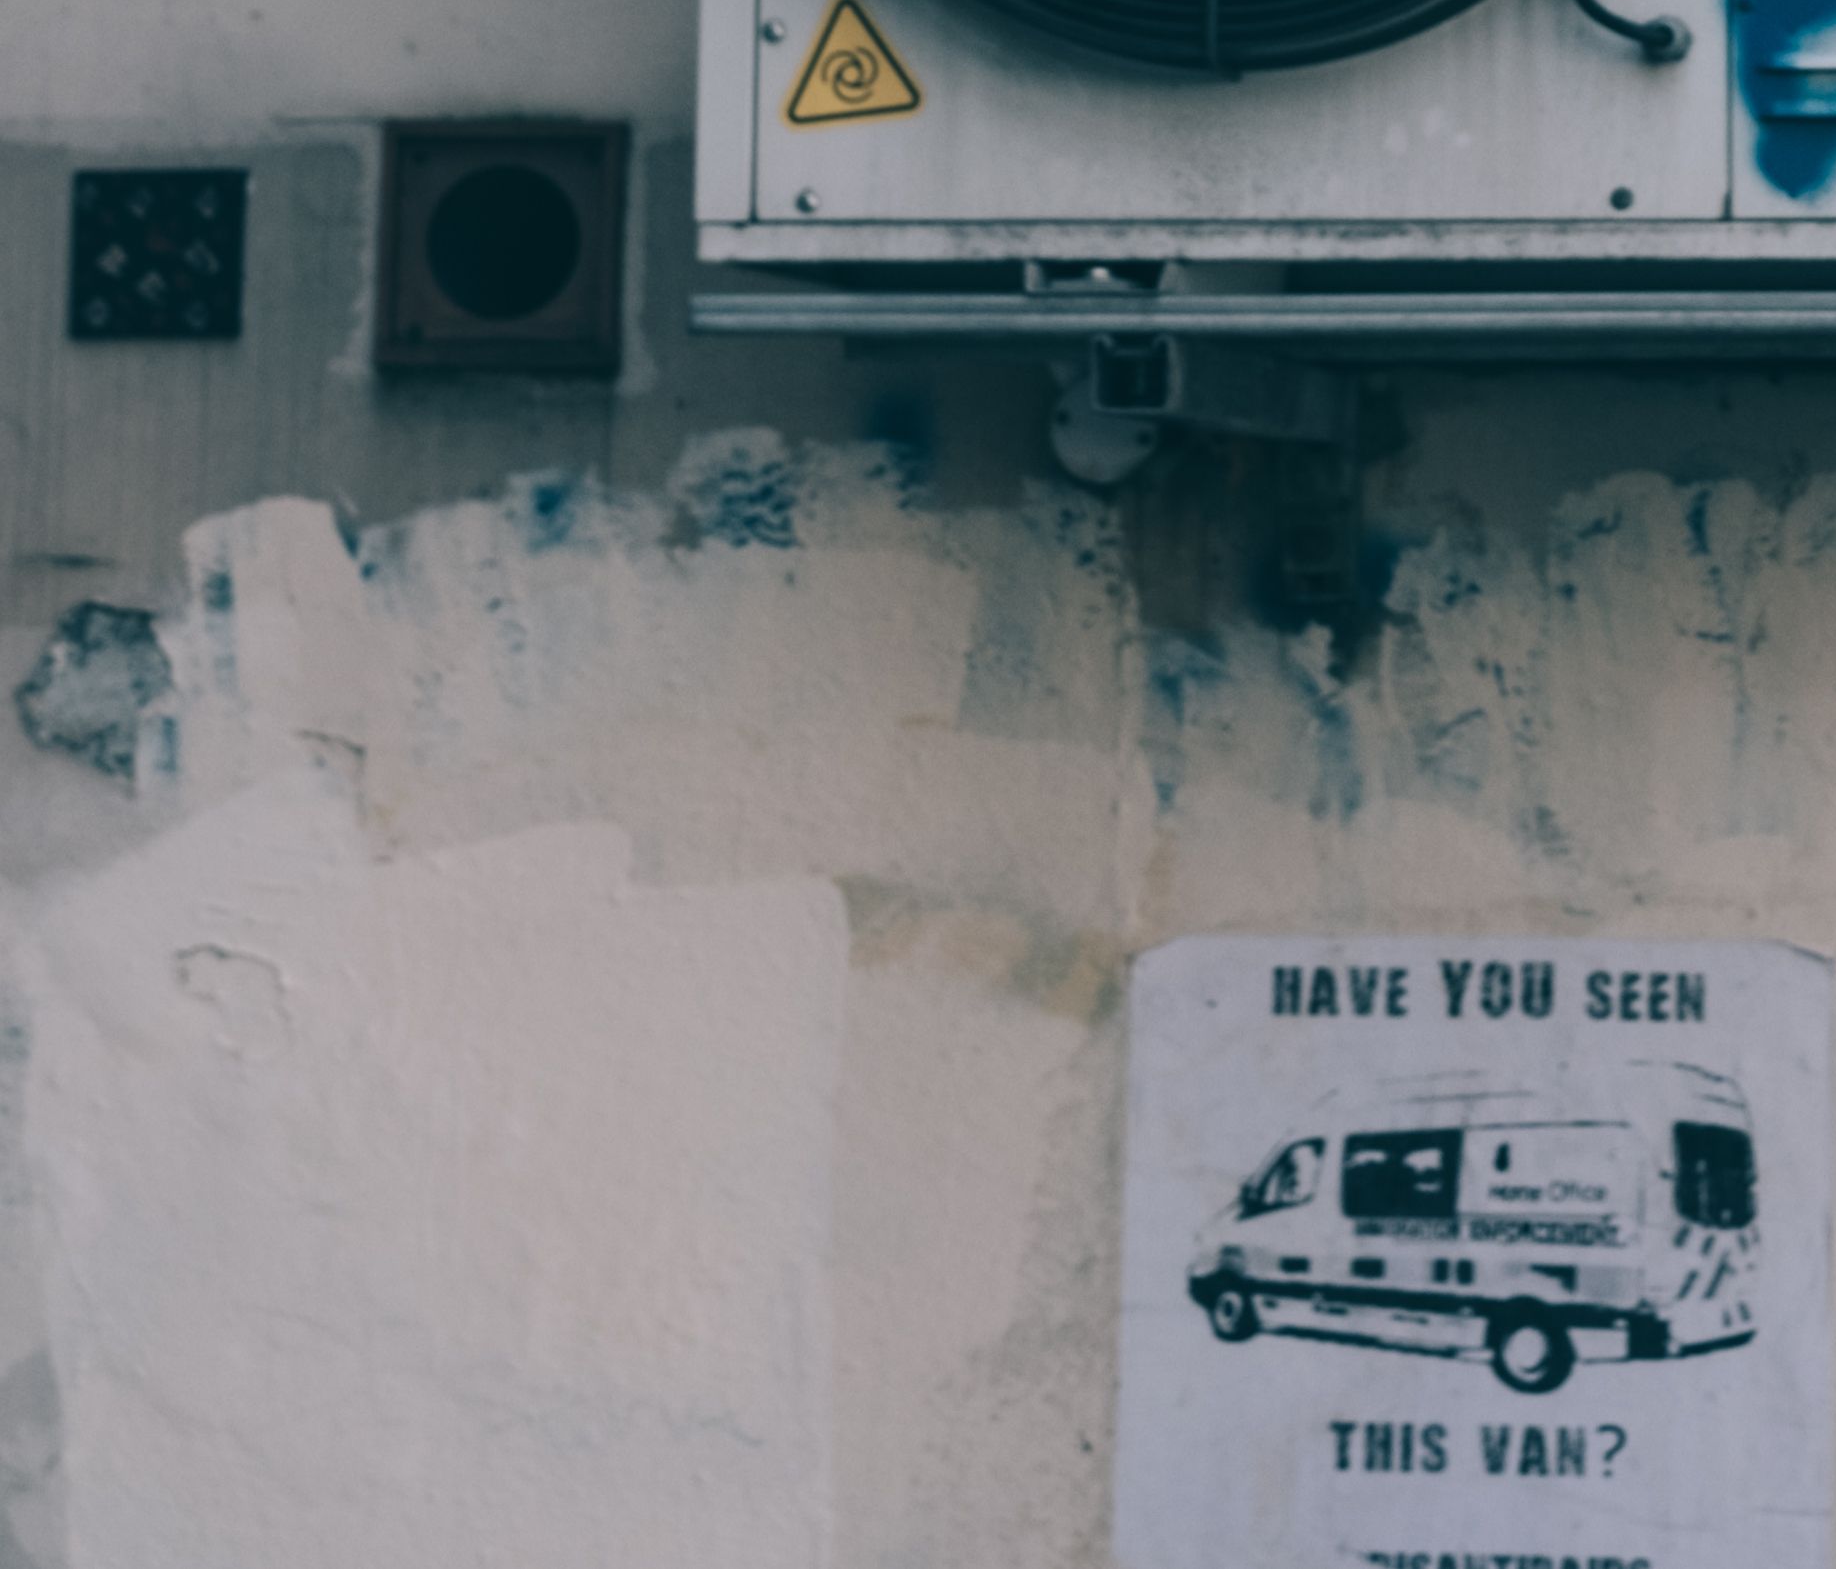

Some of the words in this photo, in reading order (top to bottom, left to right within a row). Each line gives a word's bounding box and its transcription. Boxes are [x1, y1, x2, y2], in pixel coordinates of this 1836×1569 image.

[1270, 964, 1409, 1019] HAVE
[1439, 958, 1557, 1020] YOU
[1584, 969, 1707, 1024] SEEN
[1328, 1419, 1449, 1474] THIS
[1479, 1422, 1630, 1480] VAN?
